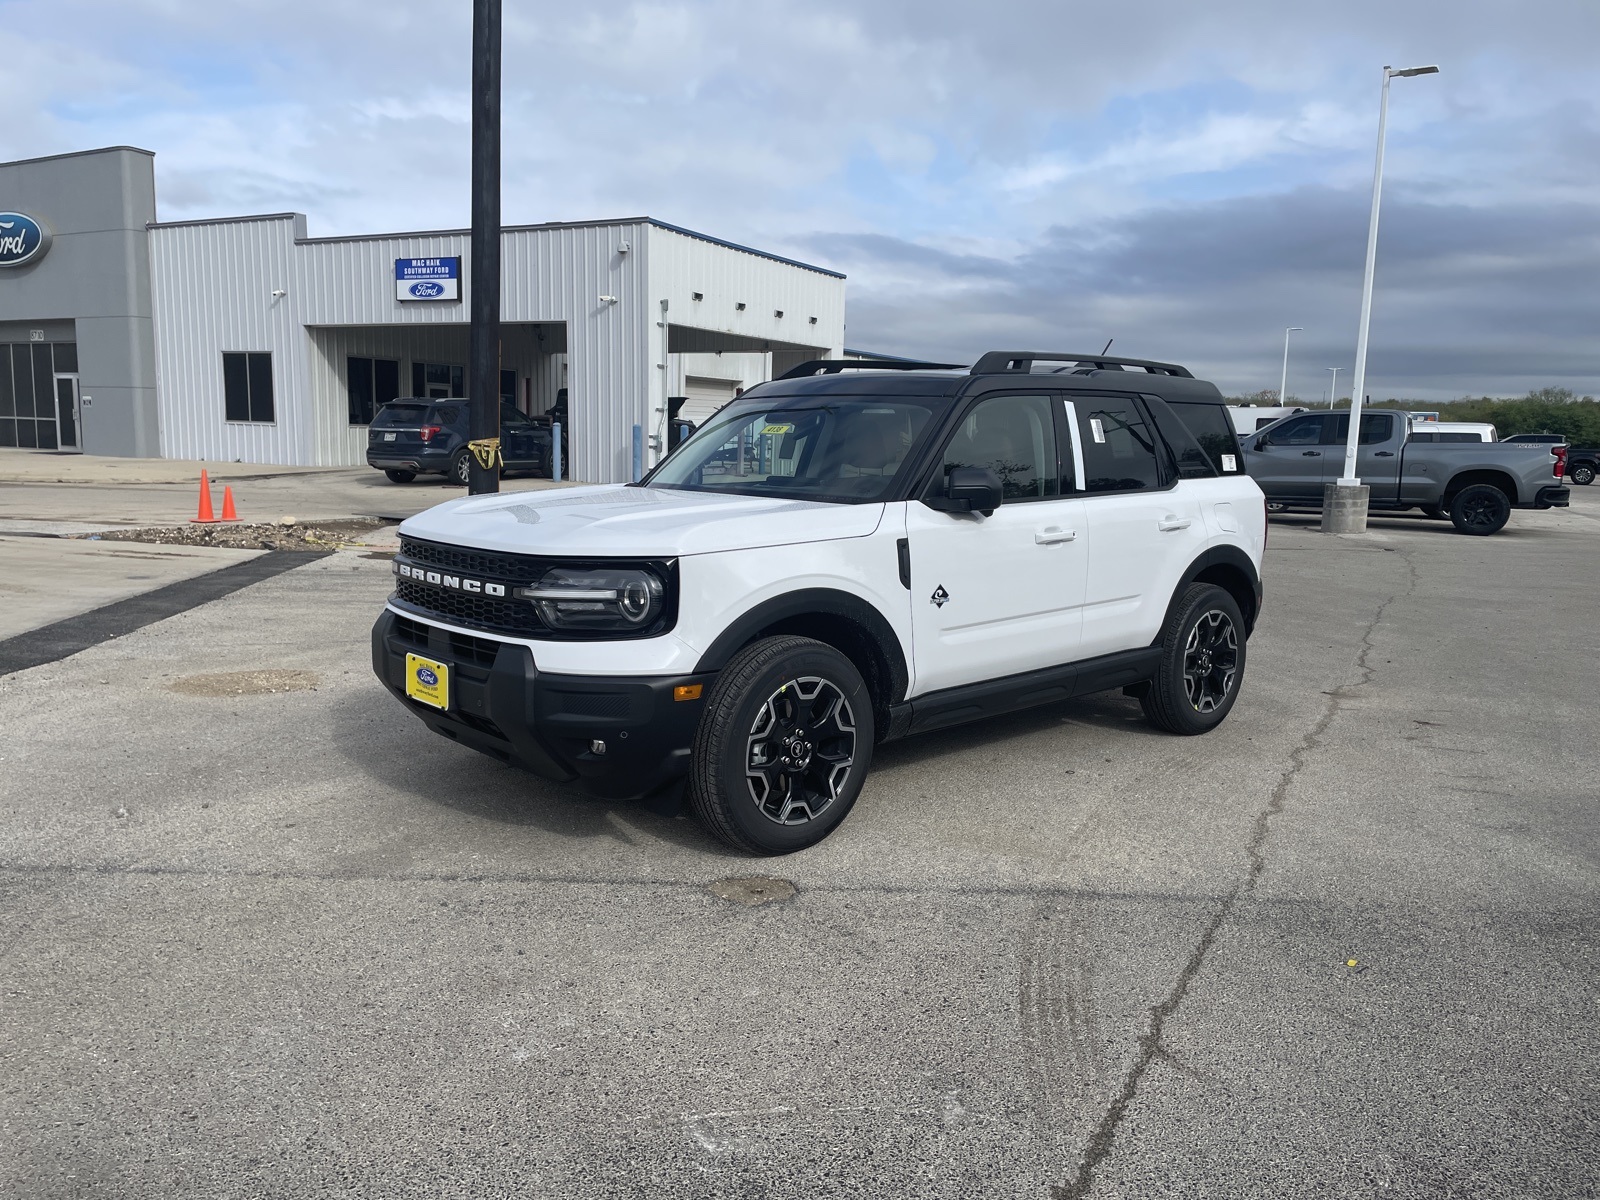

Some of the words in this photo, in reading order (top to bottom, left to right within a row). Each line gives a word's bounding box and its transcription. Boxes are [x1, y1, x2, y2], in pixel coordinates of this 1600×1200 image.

[0, 221, 26, 254] ord
[411, 259, 425, 267] MAC
[426, 258, 441, 266] HAIK
[404, 267, 433, 275] SOUTHWAY
[434, 266, 449, 274] FORD
[415, 283, 438, 296] Ford
[399, 564, 505, 597] BRONCO
[420, 669, 435, 684] Ford
